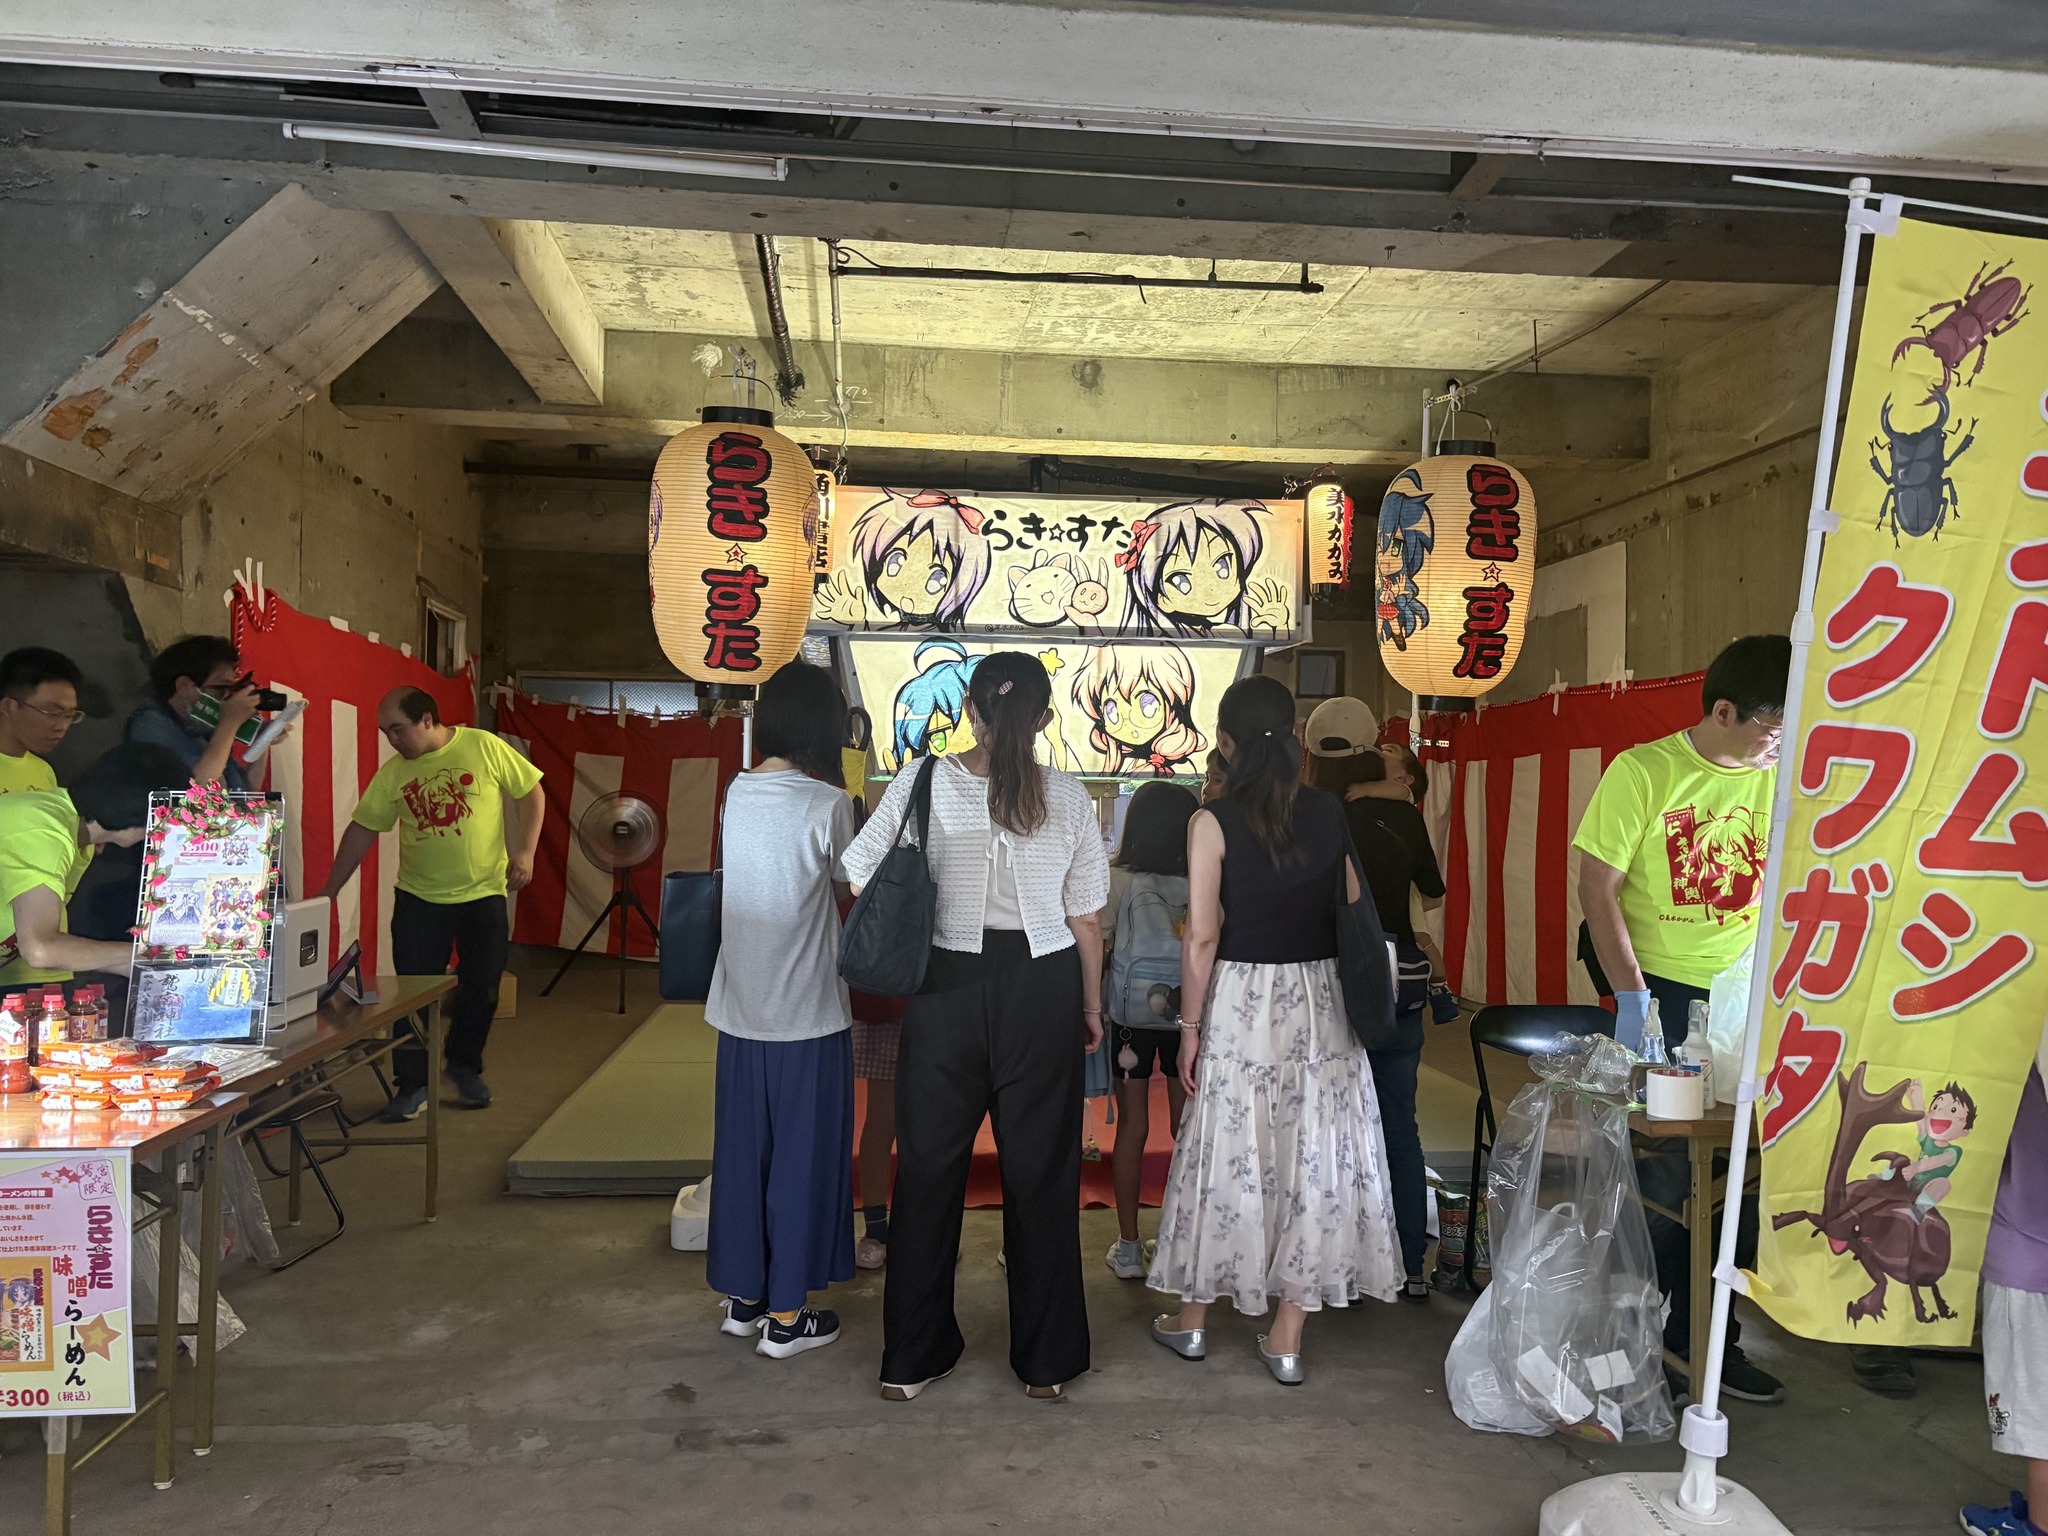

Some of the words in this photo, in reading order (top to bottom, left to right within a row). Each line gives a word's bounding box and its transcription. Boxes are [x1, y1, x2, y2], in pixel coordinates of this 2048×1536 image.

[706, 431, 772, 672] らき☆すた
[981, 509, 1132, 552] らき☆すた
[1453, 463, 1521, 679] らき☆すた
[1762, 560, 1955, 1151] クワガタ
[86, 1205, 114, 1292] らき☆すた
[803, 1318, 817, 1335] N
[57, 1391, 91, 1402] (税込)
